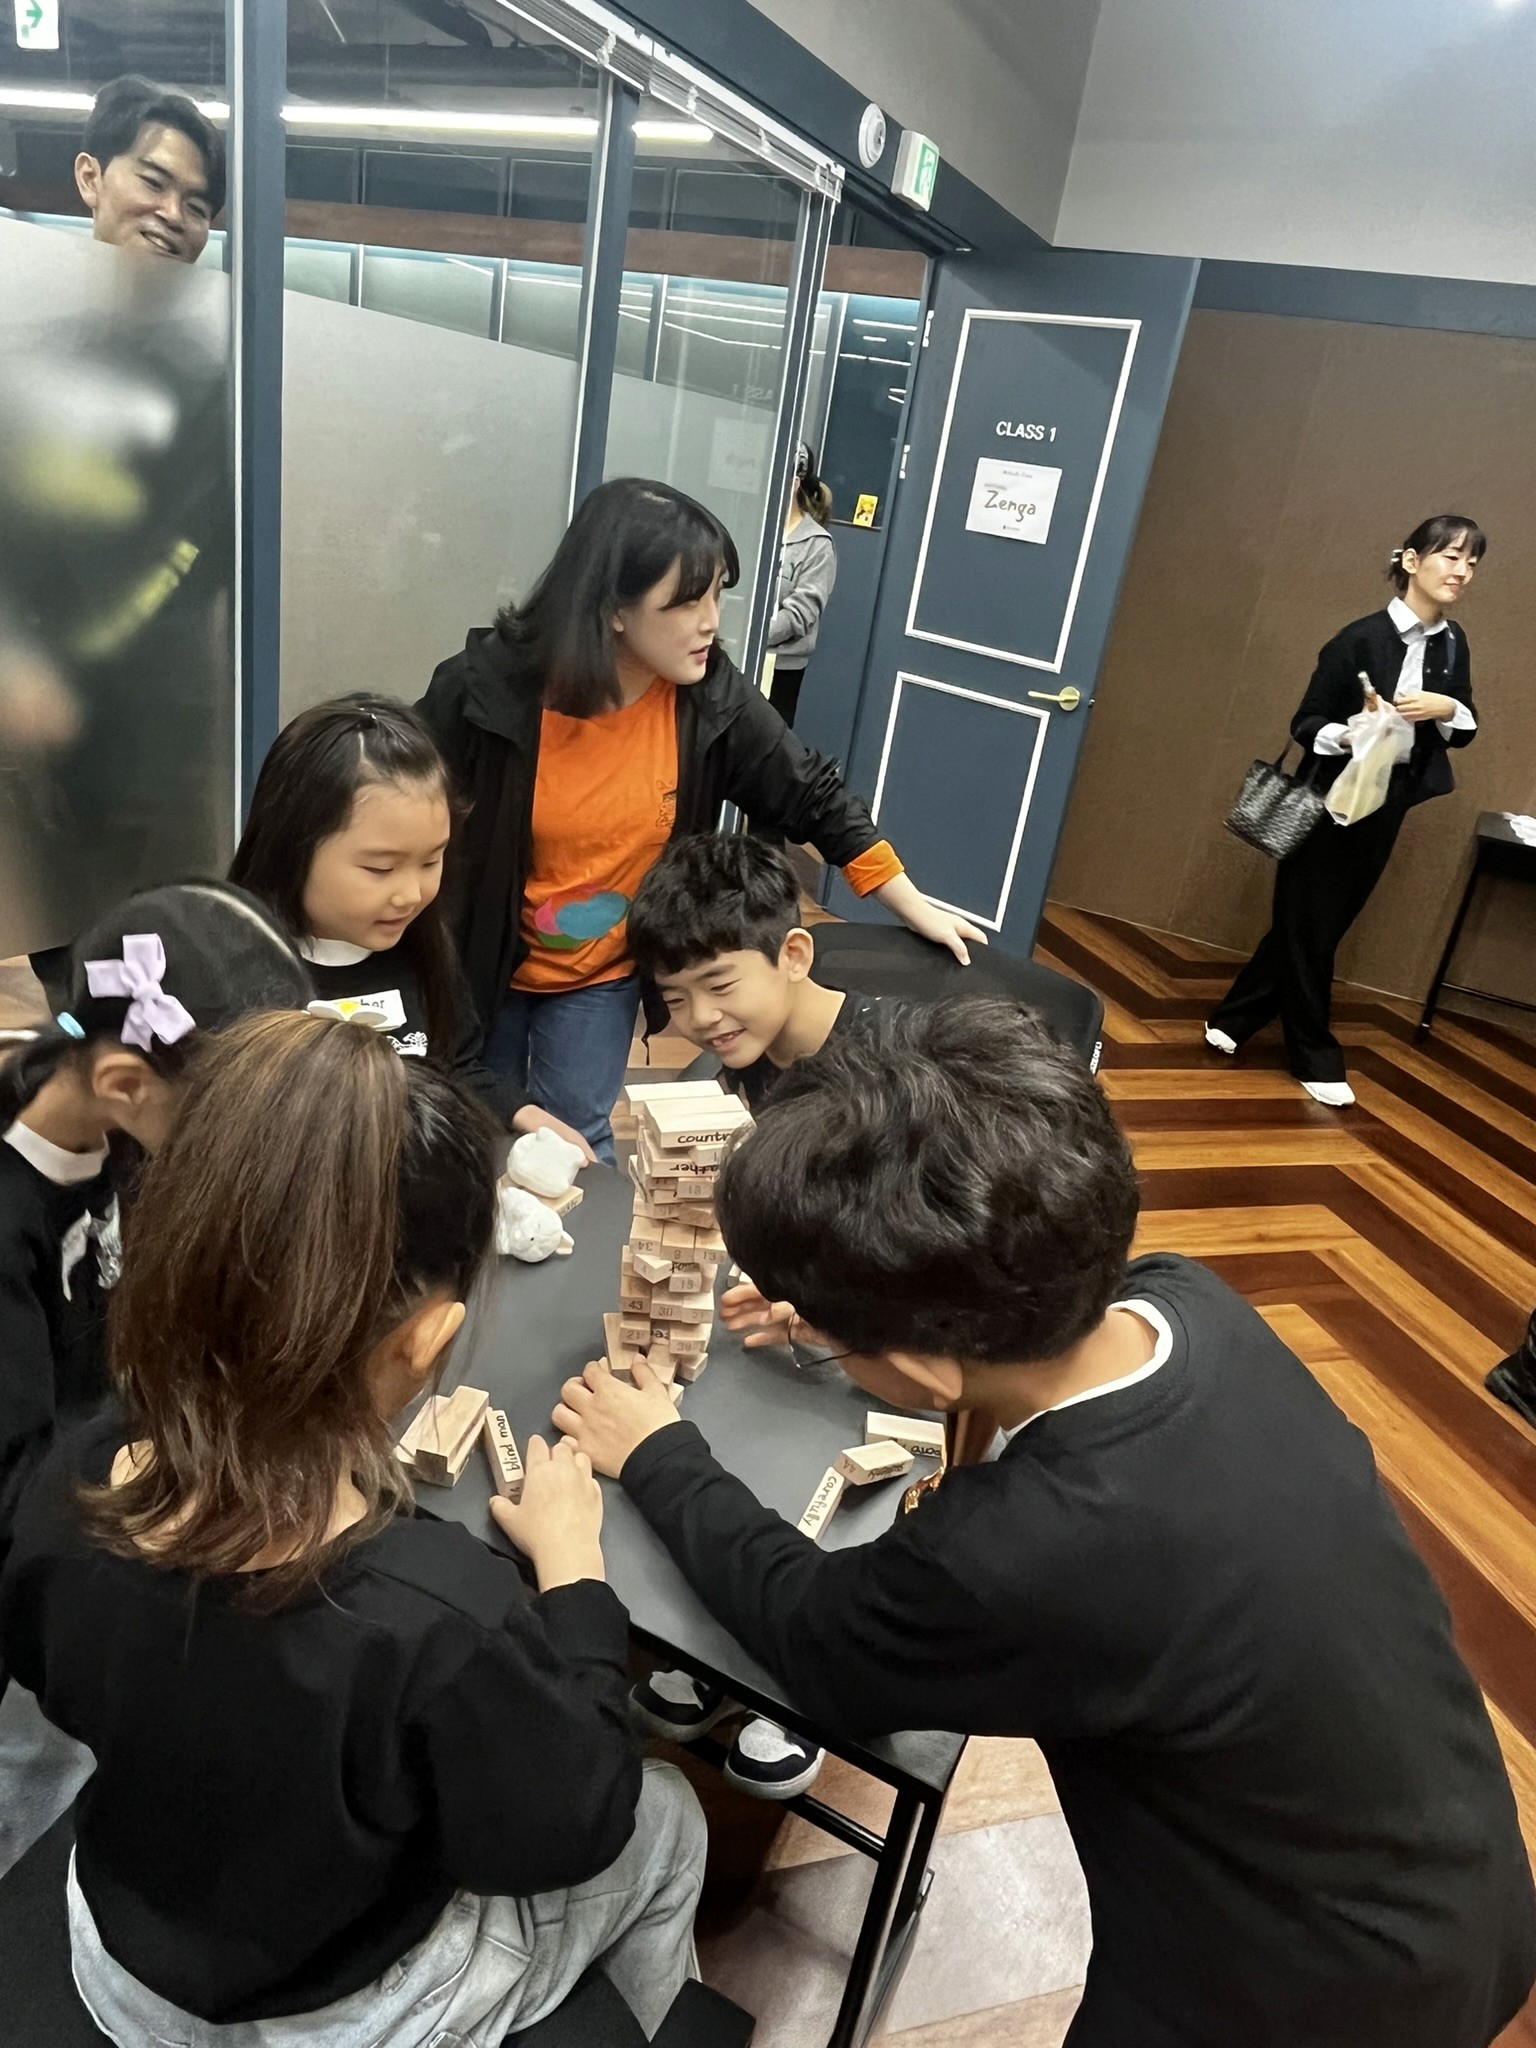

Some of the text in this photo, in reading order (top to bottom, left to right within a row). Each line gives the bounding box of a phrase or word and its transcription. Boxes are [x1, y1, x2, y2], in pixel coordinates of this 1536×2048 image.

[995, 421, 1057, 442] CLASS 1
[984, 489, 1037, 522] Zenga
[677, 1131, 730, 1144] countr
[669, 1163, 719, 1175] ather
[628, 1300, 643, 1310] 43
[496, 1415, 509, 1438] man
[499, 1443, 521, 1472] blind
[803, 1476, 837, 1526] carefully
